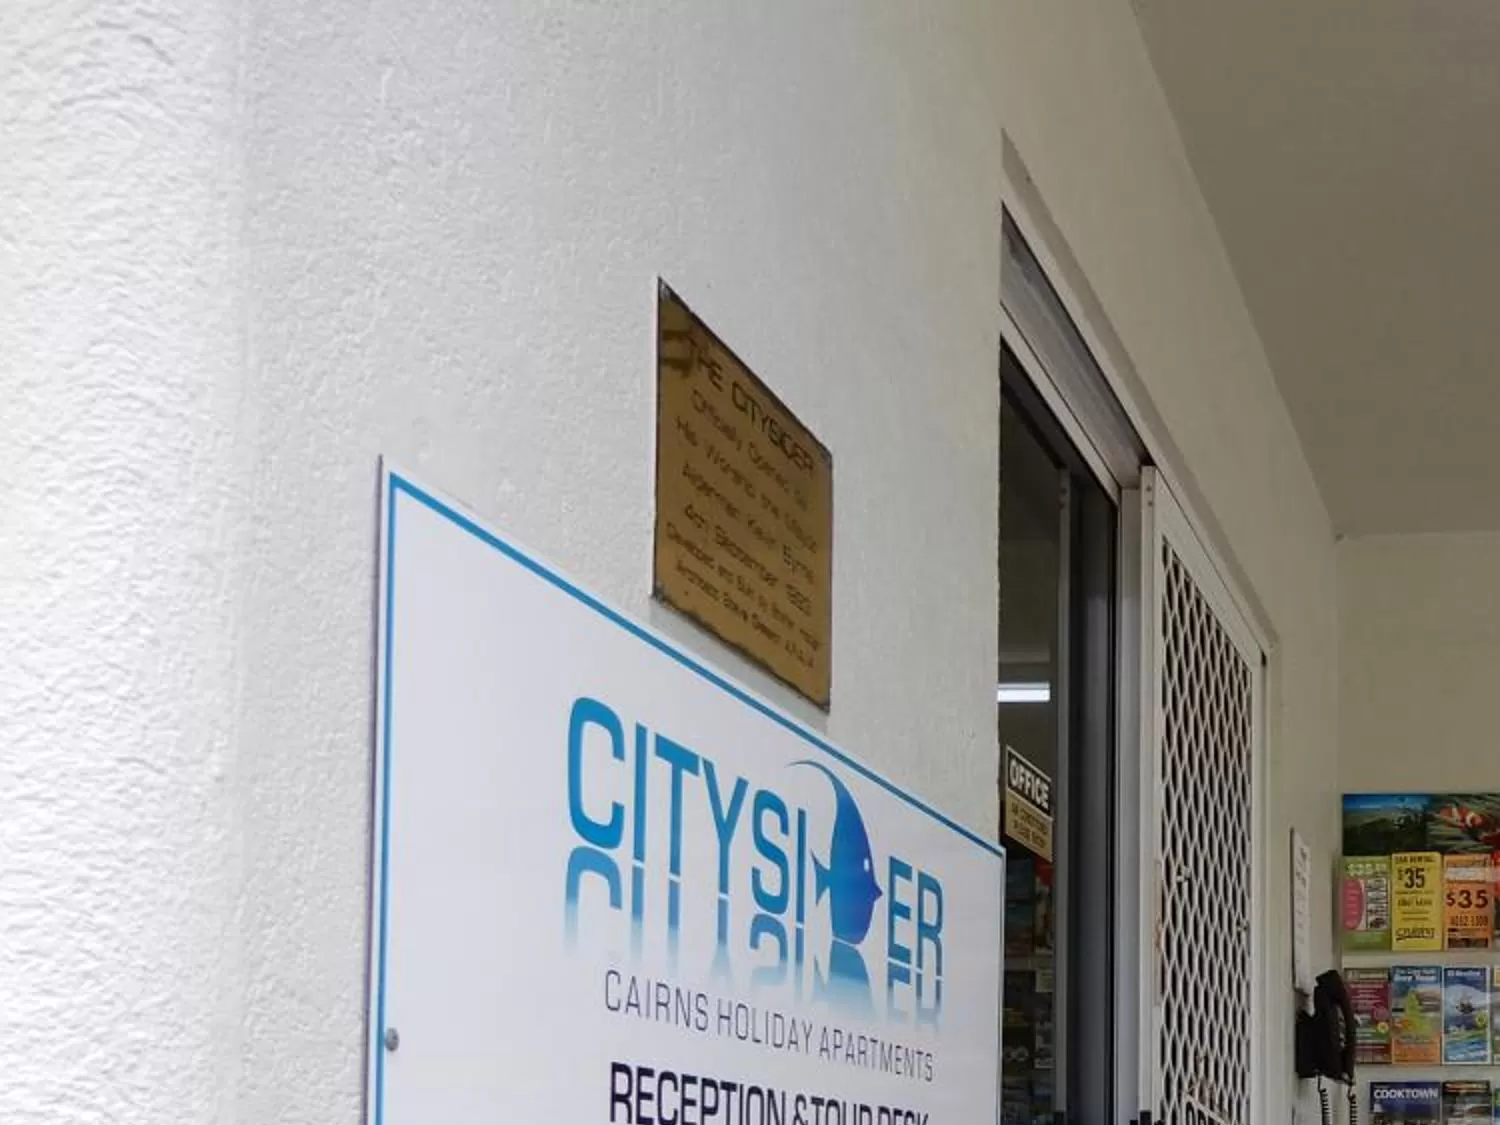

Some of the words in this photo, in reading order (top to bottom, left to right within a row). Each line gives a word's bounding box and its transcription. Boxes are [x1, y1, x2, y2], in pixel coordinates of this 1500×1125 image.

[1008, 757, 1050, 812] OFFICE
[1398, 867, 1426, 889] $35
[1446, 889, 1489, 909] $35
[605, 970, 709, 1031] CAIRNS
[718, 999, 812, 1052] HOLIDAY
[820, 1027, 933, 1082] APARTMENTS
[1373, 1087, 1440, 1099] COOKTOWN
